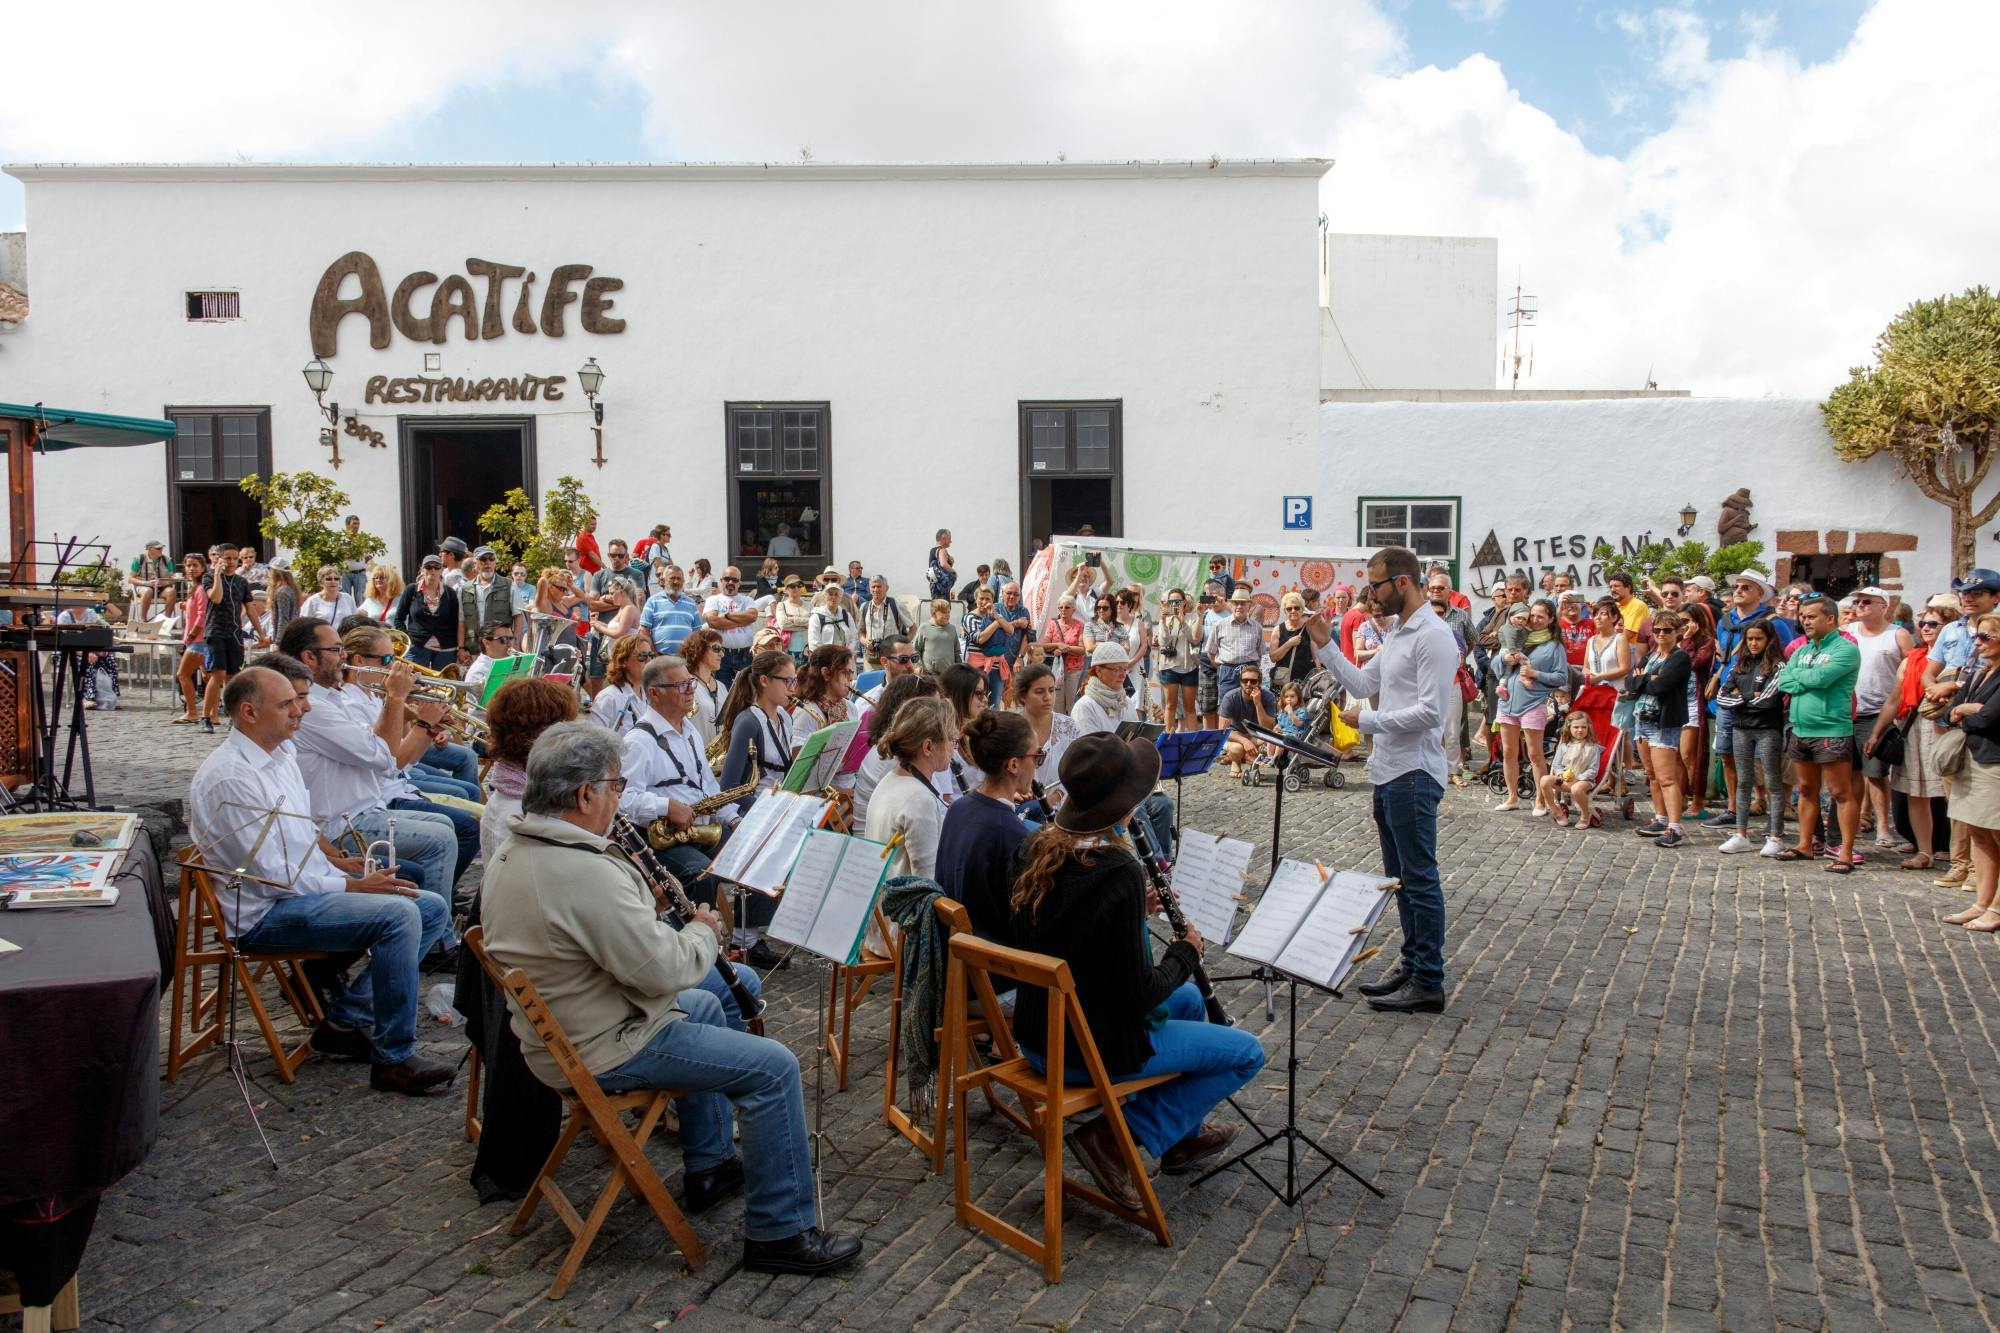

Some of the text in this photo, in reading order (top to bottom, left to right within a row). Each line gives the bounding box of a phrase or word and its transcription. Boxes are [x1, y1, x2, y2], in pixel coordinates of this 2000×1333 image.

[365, 375, 566, 404] RESTAURANTE
[344, 416, 387, 448] BAR
[1287, 498, 1308, 523] P
[513, 986, 554, 1042] AYTO
